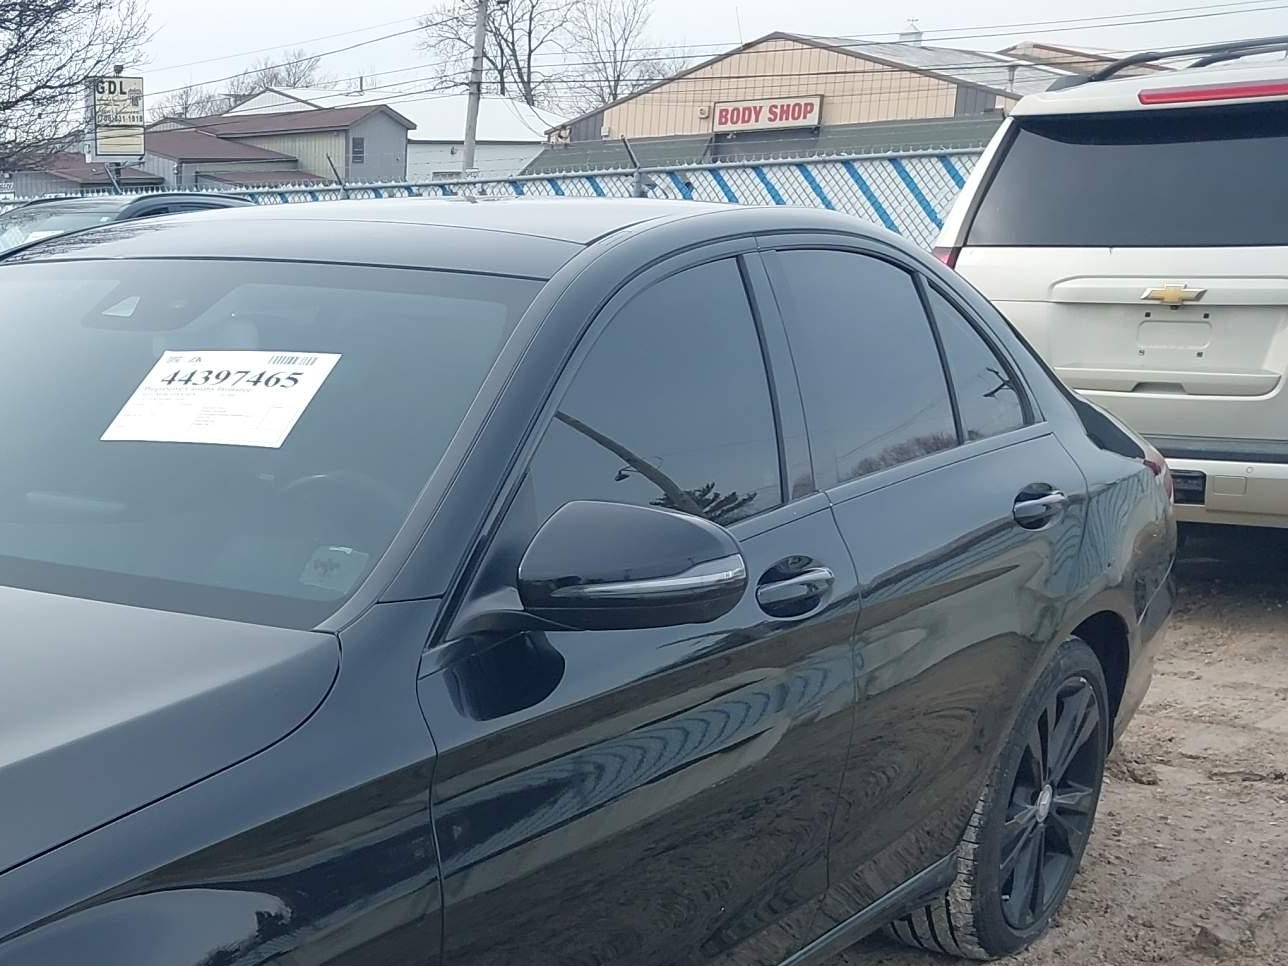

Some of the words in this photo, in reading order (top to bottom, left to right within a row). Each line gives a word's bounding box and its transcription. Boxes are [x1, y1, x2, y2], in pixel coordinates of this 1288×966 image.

[96, 80, 127, 95] GDL
[718, 105, 763, 126] BODY
[767, 102, 815, 122] SHOP
[161, 369, 304, 388] 44397465
